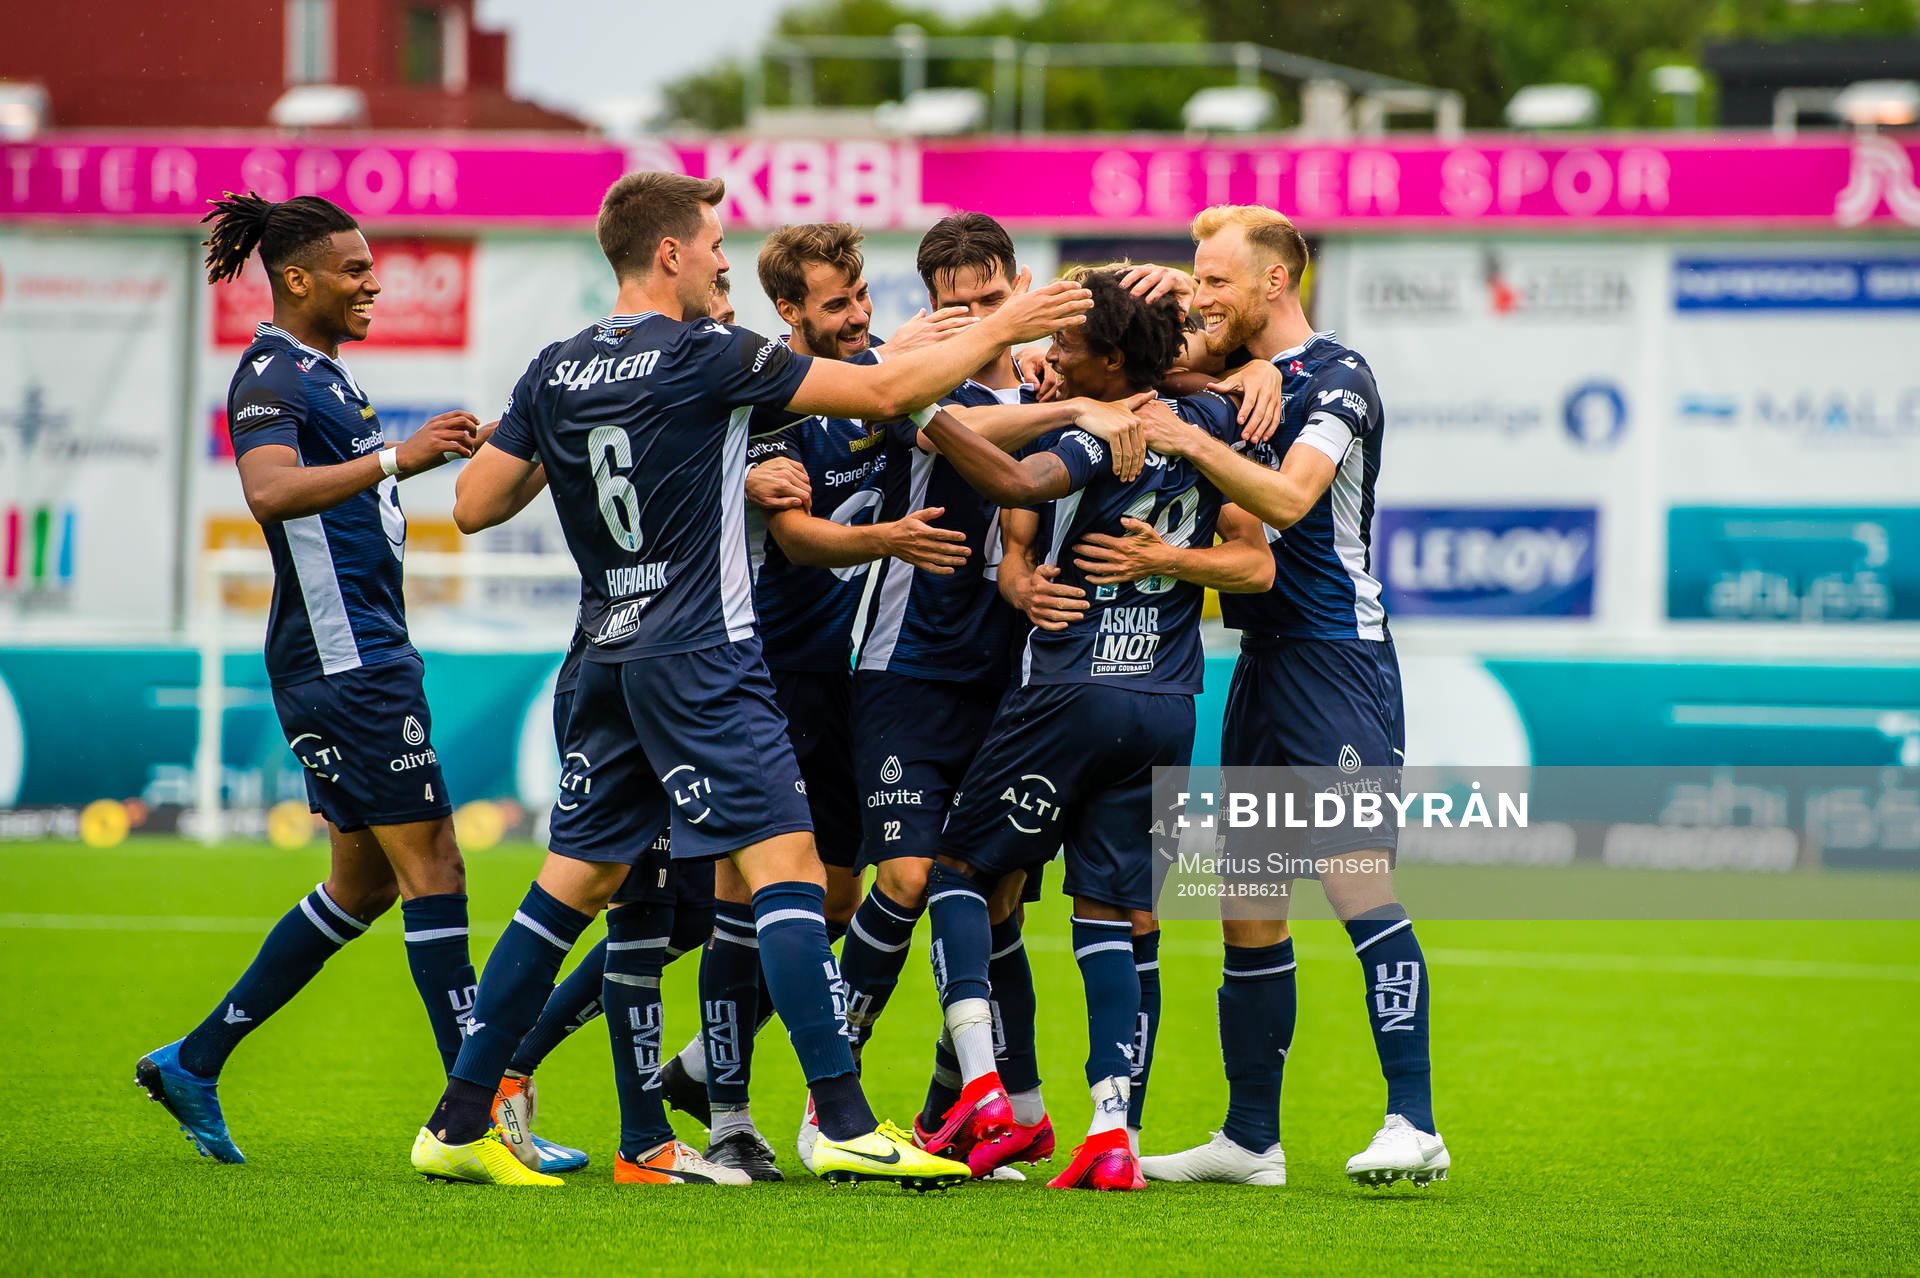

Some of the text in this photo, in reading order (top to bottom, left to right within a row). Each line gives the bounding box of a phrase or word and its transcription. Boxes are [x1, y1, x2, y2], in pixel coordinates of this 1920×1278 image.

[704, 139, 954, 227] KBBL
[1090, 146, 1671, 217] SETTER SPOR
[236, 402, 281, 421] altibox
[1344, 389, 1368, 412] INTER
[351, 430, 384, 454] SpareBan
[588, 425, 644, 552] 6
[1100, 606, 1159, 634] ASKAR
[1102, 634, 1161, 661] MOT
[1096, 665, 1117, 673] SHOW
[302, 746, 342, 768] LTI
[424, 782, 435, 803] 4
[561, 771, 592, 795] LTI
[674, 777, 712, 806] LTI
[867, 788, 923, 808] olivita
[1000, 786, 1062, 822] ALTI
[884, 820, 901, 842] 22
[1375, 960, 1420, 1033] NEAS
[705, 1000, 745, 1086] NEAS
